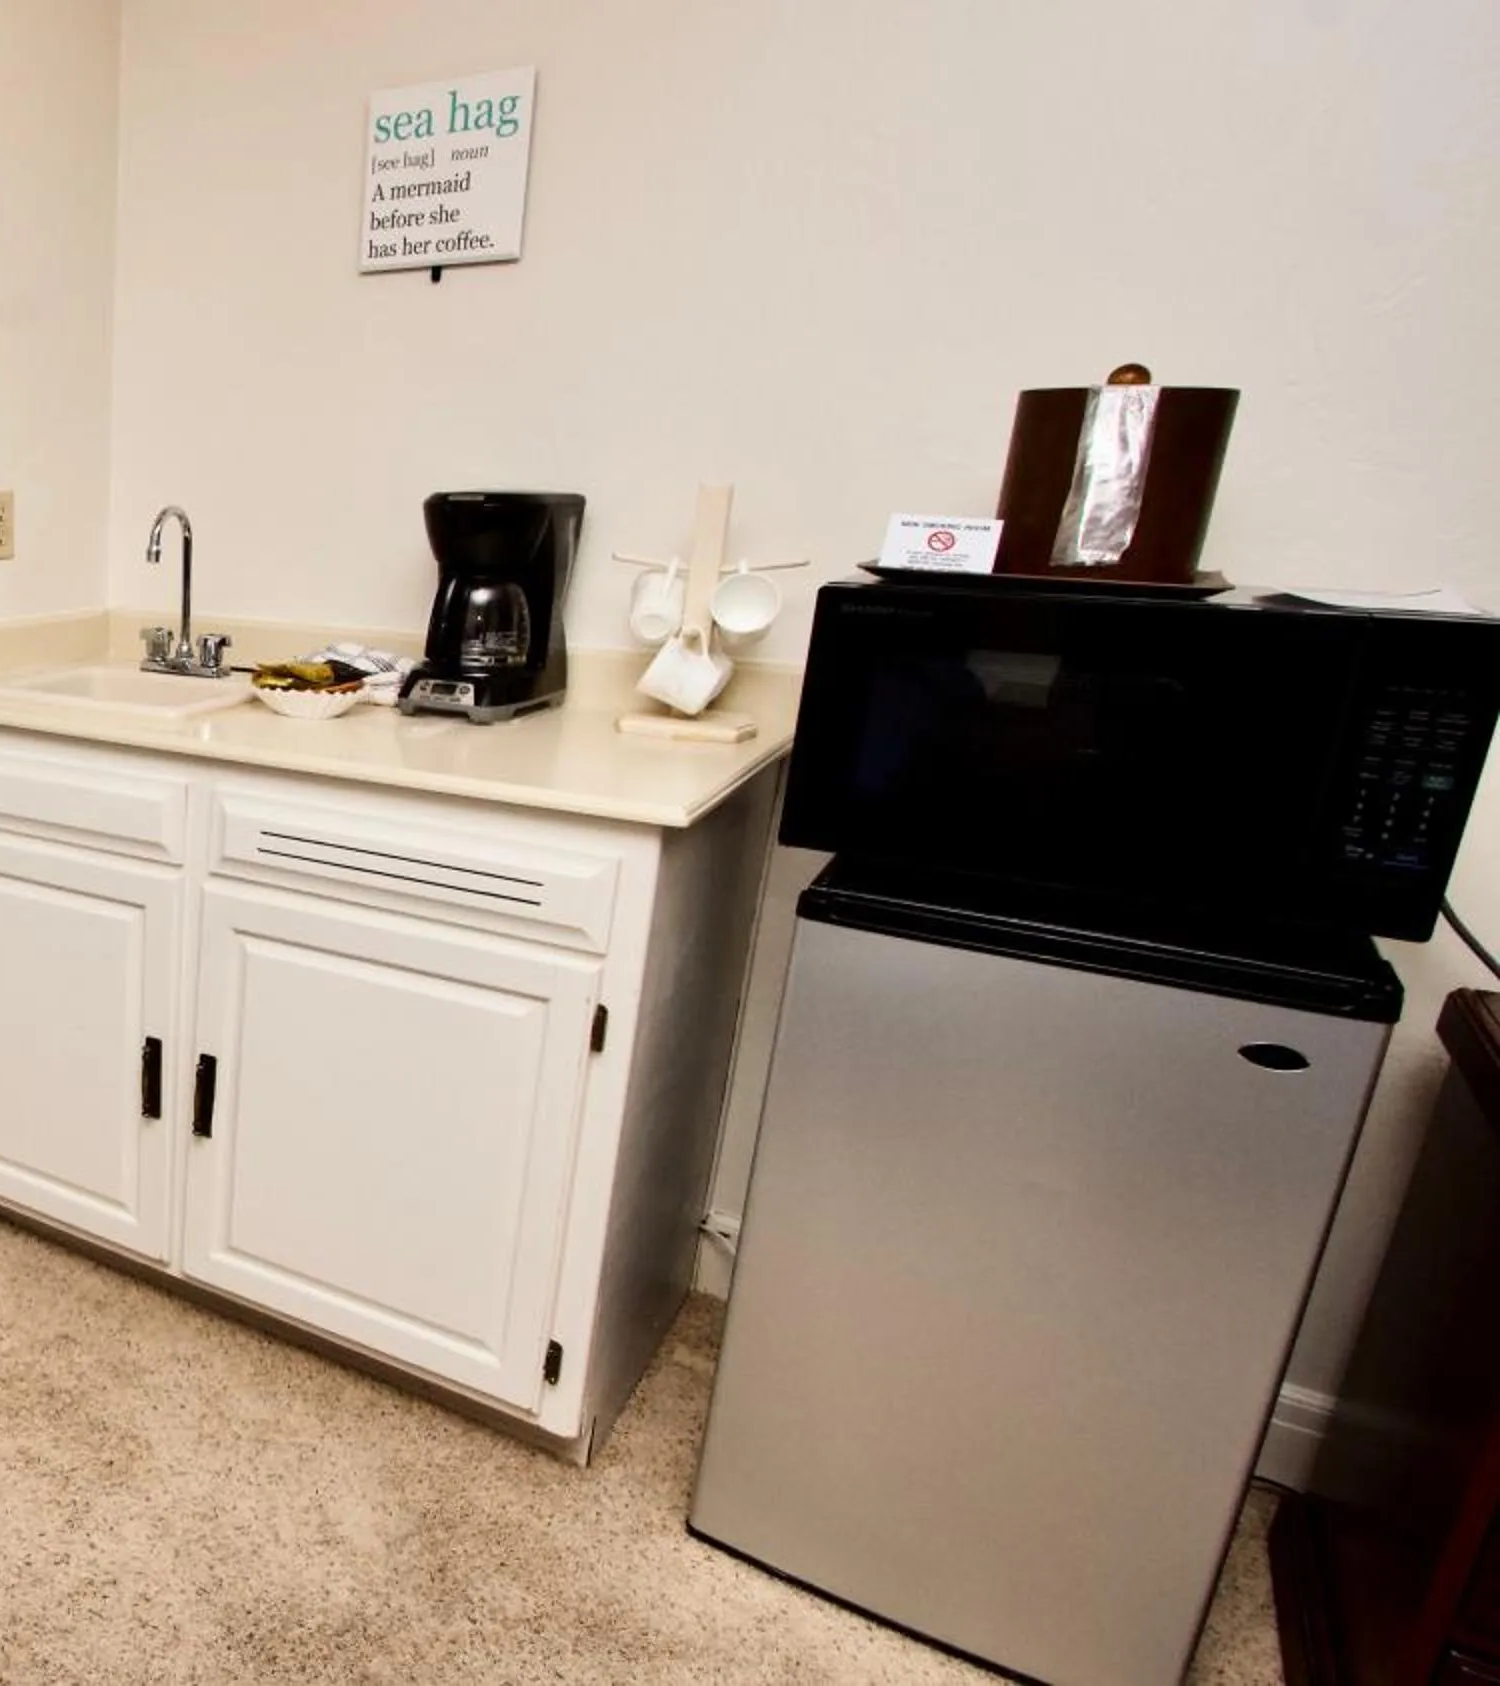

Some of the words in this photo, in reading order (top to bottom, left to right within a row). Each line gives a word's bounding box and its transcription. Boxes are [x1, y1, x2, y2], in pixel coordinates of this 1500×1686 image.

[373, 108, 434, 144] sea
[447, 90, 521, 138] hag
[450, 145, 490, 162] noun
[371, 183, 385, 202] A
[390, 171, 472, 201] mermaid
[370, 208, 425, 231] before
[428, 204, 461, 225] she
[367, 240, 397, 259] has
[401, 236, 432, 256] her
[435, 230, 496, 253] coffee.
